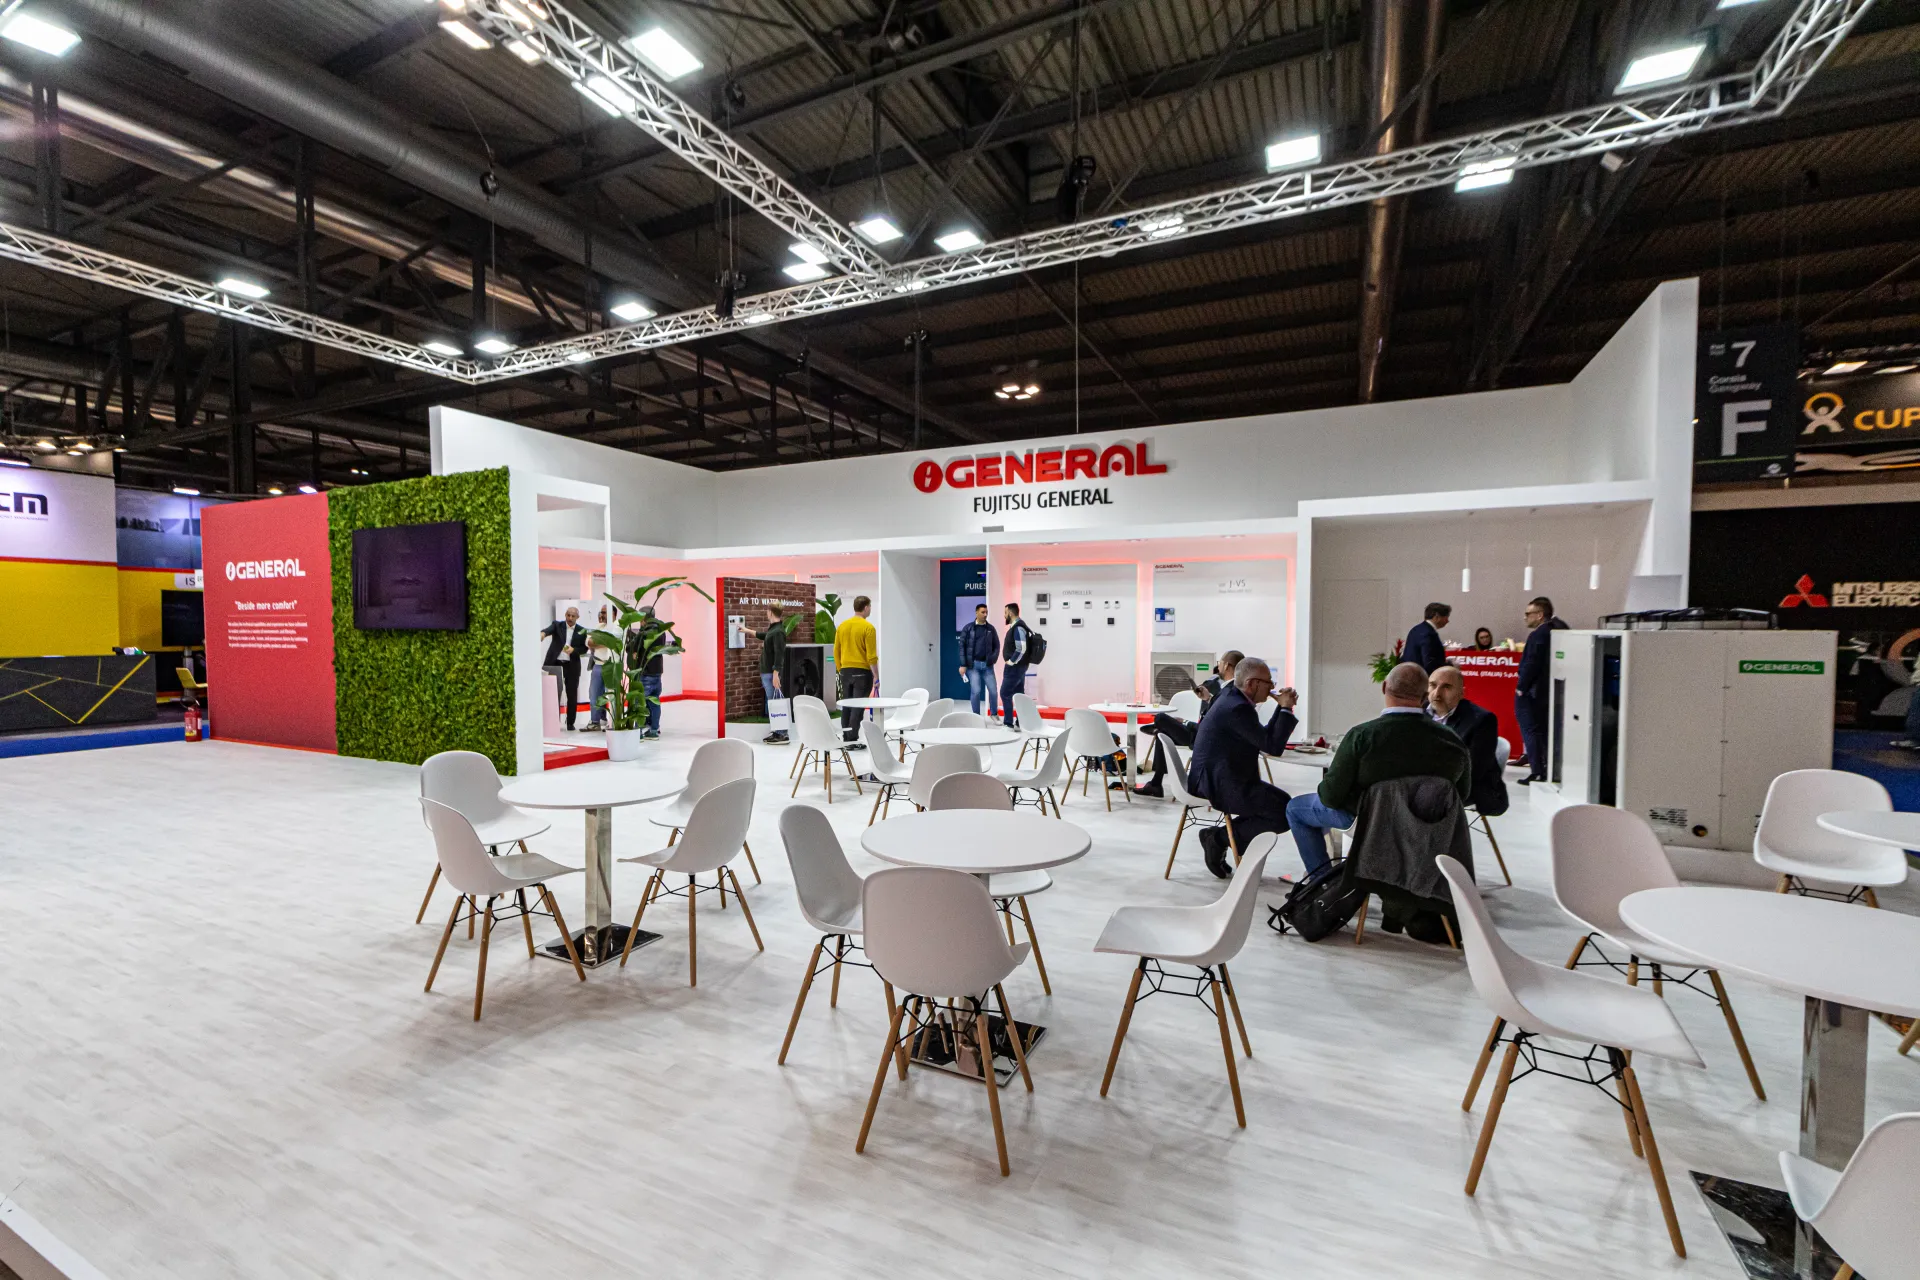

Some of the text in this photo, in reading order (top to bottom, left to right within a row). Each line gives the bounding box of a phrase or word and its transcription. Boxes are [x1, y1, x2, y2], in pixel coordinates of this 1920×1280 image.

[1730, 340, 1757, 368] 7
[1721, 400, 1772, 456] F
[945, 443, 1167, 489] GENERAL
[973, 488, 1113, 515] FUJITSU GENERAL
[236, 558, 306, 580] GENERAL
[739, 597, 749, 605] AIR
[751, 597, 760, 606] TO
[1753, 662, 1821, 672] GENERAL
